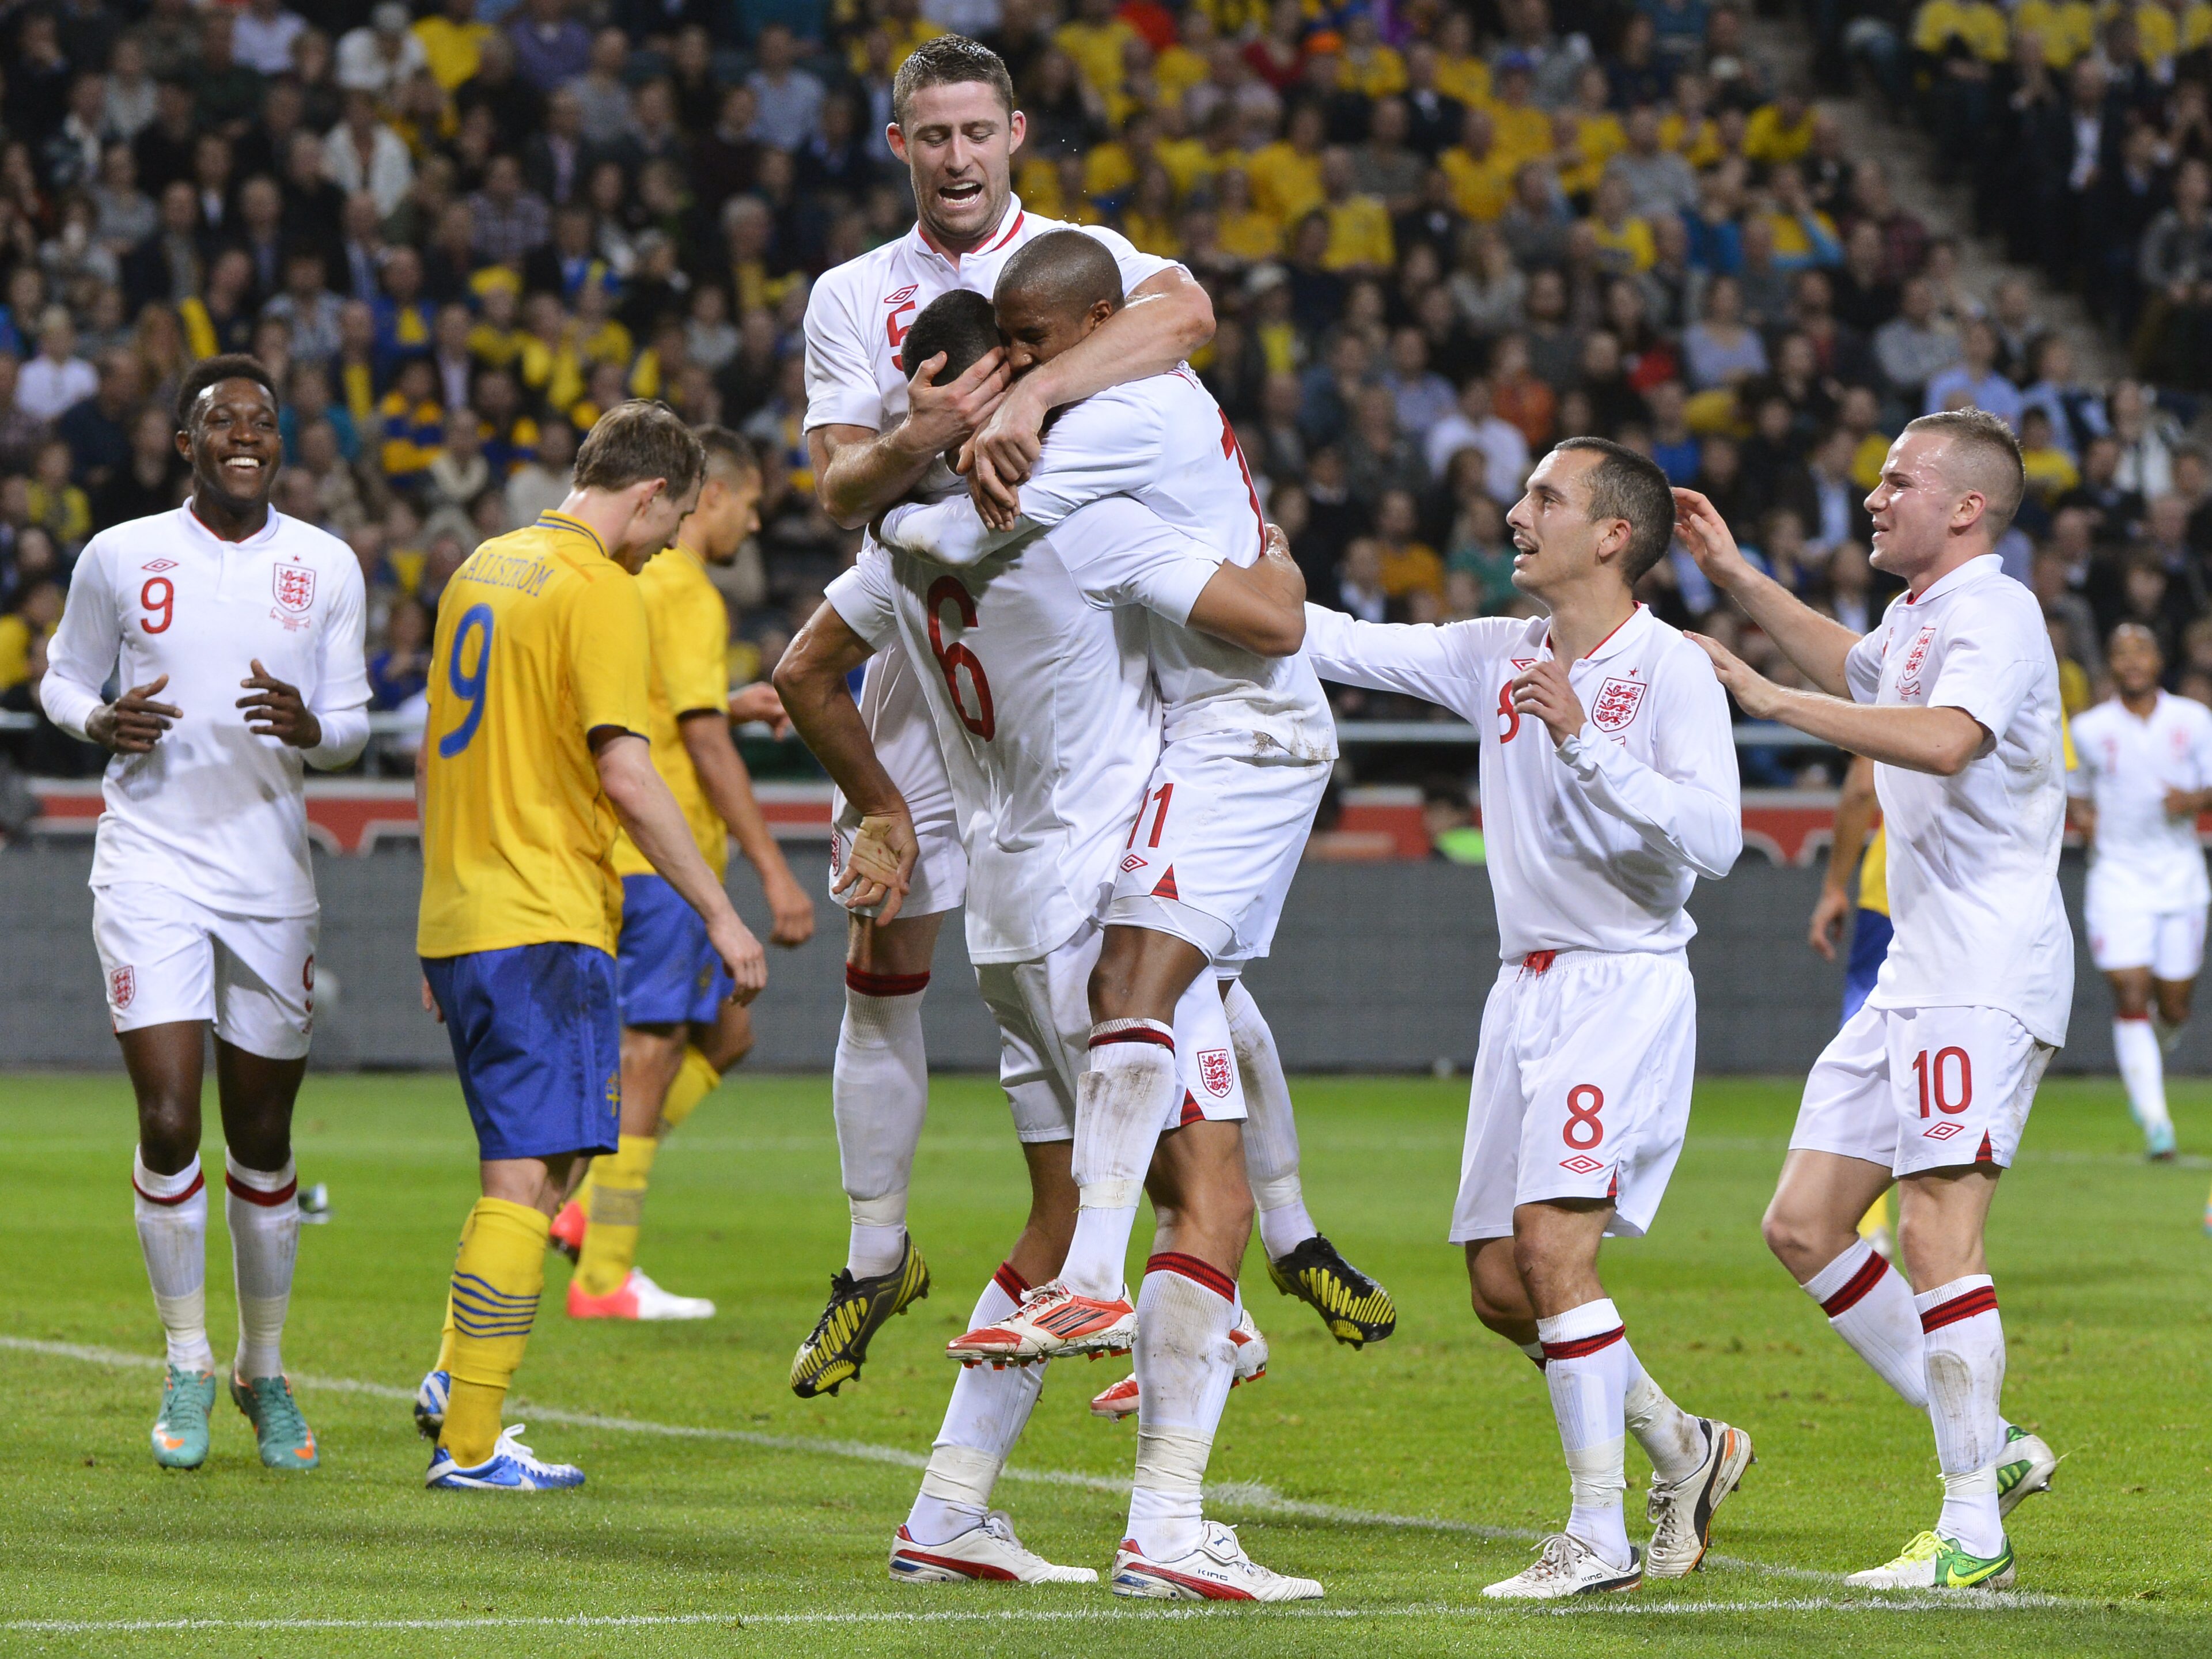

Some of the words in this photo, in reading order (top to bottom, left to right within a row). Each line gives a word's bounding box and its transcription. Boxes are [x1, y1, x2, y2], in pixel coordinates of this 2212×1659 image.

[141, 577, 175, 634] 9
[459, 546, 555, 597] ÄLLSTRÖM
[438, 603, 494, 759] 9
[927, 575, 996, 743] 6
[1562, 1084, 1605, 1151] 8
[1912, 1046, 1973, 1119] 10
